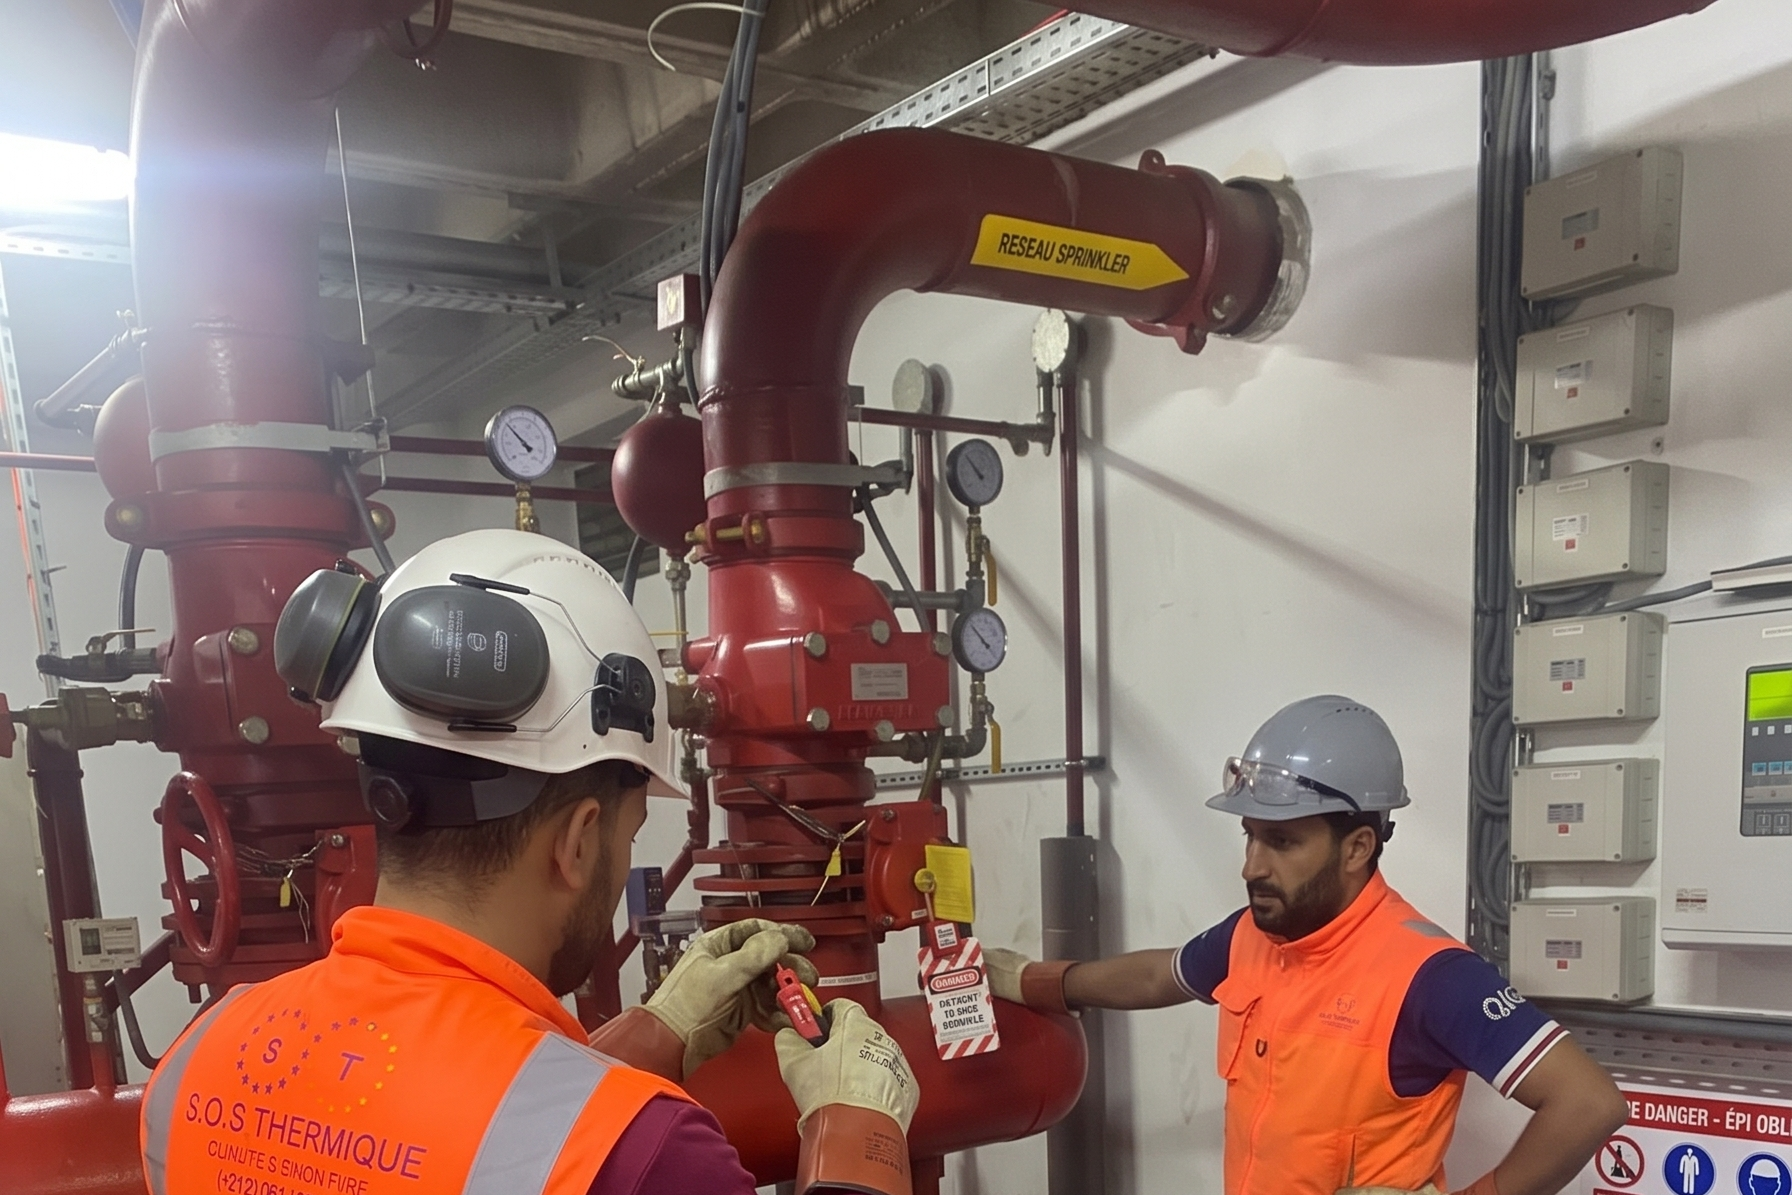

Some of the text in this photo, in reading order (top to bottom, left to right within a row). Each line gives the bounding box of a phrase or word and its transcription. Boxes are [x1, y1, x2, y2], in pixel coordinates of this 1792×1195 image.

[998, 232, 1130, 275] RESEAU SPRINKLER
[263, 1038, 364, 1081] S T
[186, 1093, 427, 1180] S.O.S THERMIQUE
[1645, 1102, 1708, 1127] DANGER
[1725, 1107, 1751, 1132] ÉPI
